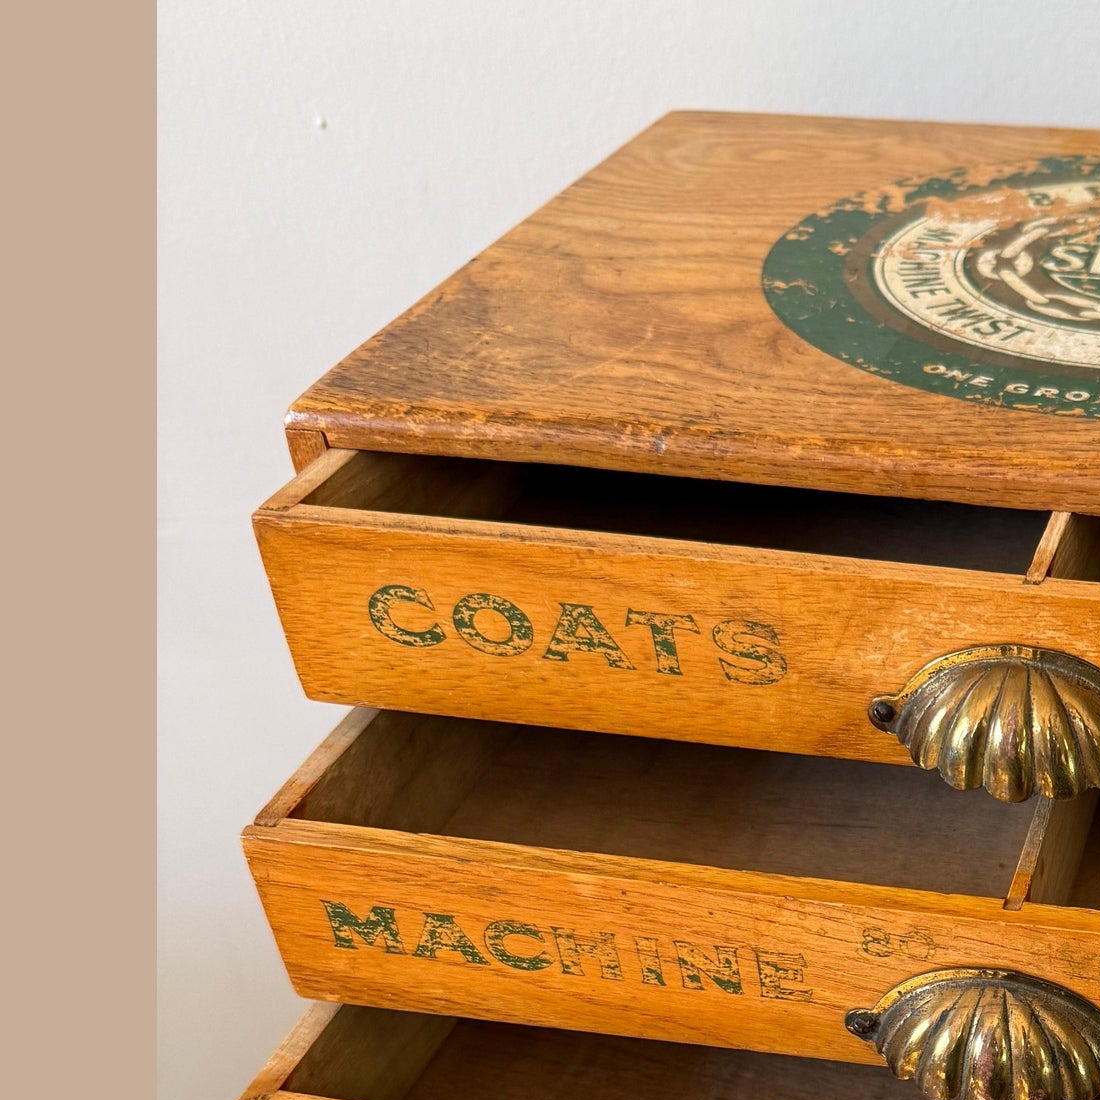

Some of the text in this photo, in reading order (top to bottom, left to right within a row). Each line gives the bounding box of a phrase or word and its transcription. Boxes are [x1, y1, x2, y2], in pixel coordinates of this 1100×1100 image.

[925, 298, 1036, 341] TWIST
[922, 363, 996, 389] ONE
[367, 584, 790, 686] COATS
[320, 899, 814, 1002] MACHINE
